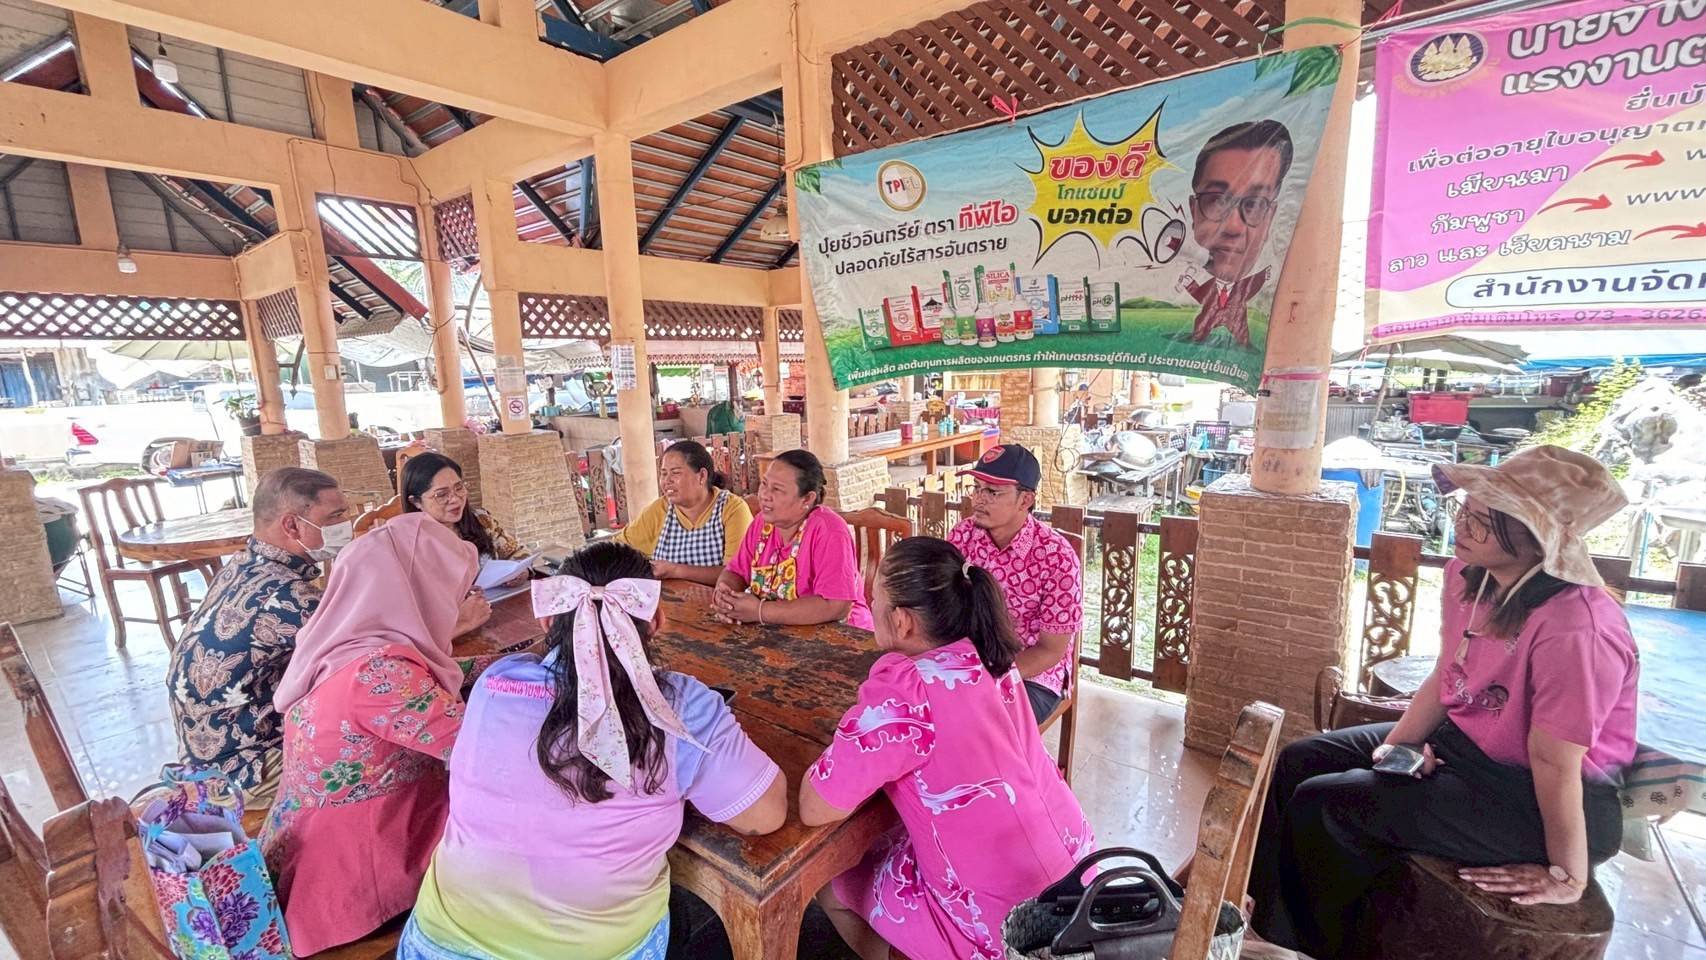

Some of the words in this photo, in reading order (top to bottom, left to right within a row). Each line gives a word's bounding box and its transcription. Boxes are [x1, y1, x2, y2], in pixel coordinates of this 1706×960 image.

[1050, 141, 1153, 180] ของดี
[1447, 165, 1569, 198] เมียนมา
[924, 218, 955, 236] ตรา
[958, 199, 1017, 231] ทีพีไอ
[1047, 203, 1133, 224] บอกต่อ
[1431, 208, 1525, 234] กัมพูชา
[835, 237, 1007, 275] ปลอดภัยไร้สารอันตราย
[1388, 254, 1428, 273] ลาว
[1438, 244, 1488, 263] และ
[1498, 230, 1632, 256] เวียดนาม
[986, 271, 1010, 280] SILICA
[1574, 310, 1615, 321] 073
[1641, 308, 1706, 320] 3626
[848, 364, 896, 381] เพิ่มผลผลิต
[897, 352, 1031, 371] ลดต้นทุนการผลิตของเกษตรกร
[1033, 351, 1147, 365] ทำให้เกษตรกรอยู่ดีกินดี
